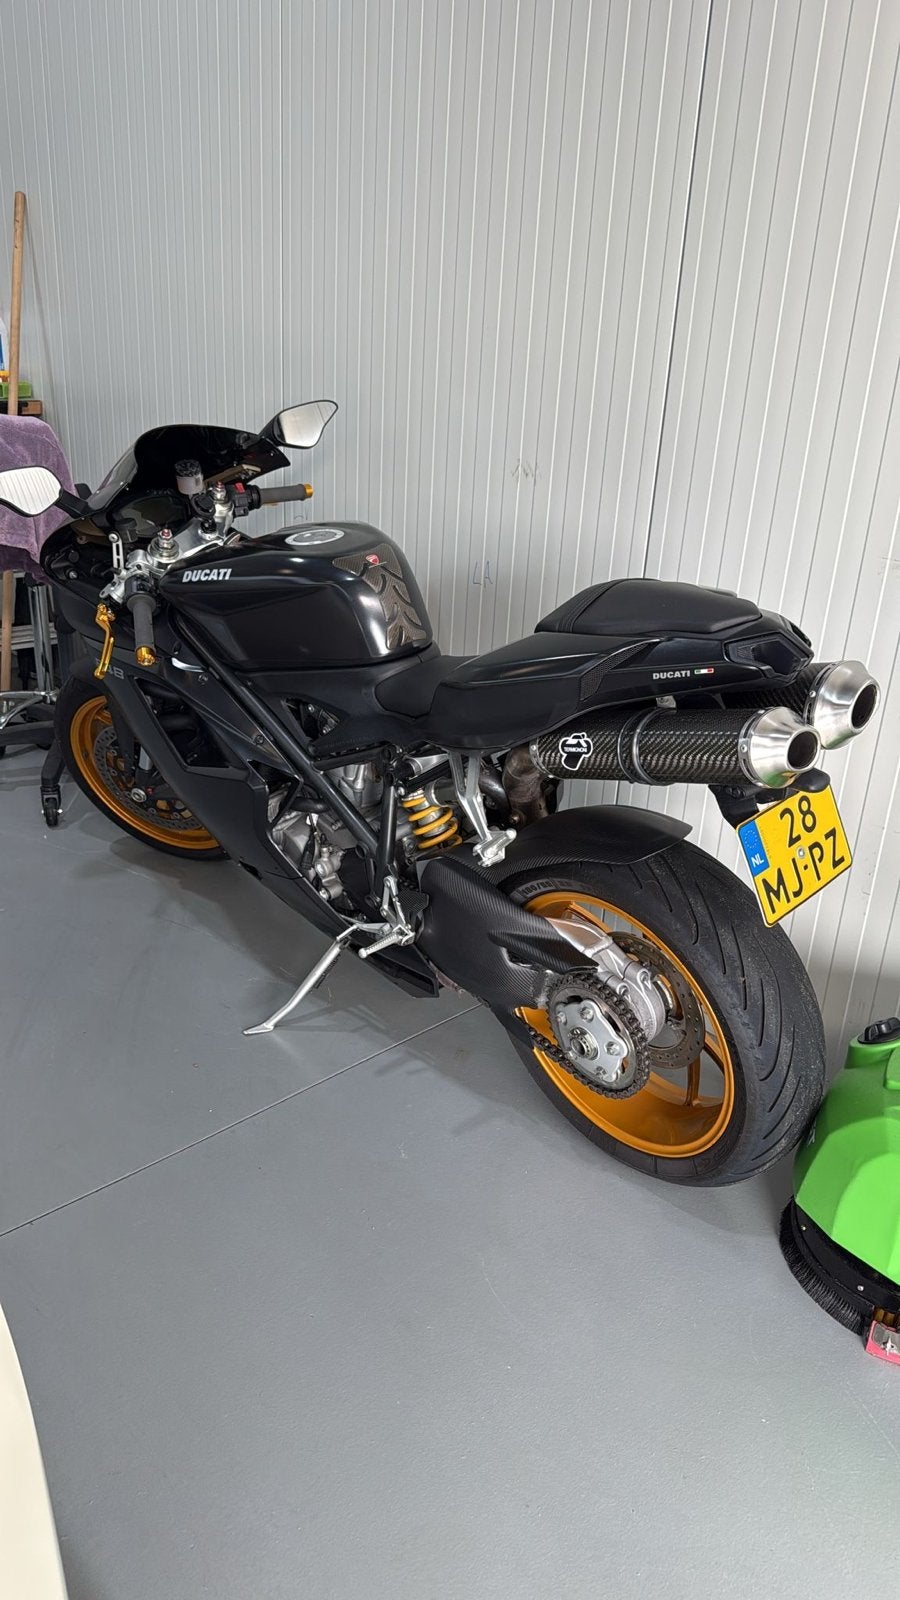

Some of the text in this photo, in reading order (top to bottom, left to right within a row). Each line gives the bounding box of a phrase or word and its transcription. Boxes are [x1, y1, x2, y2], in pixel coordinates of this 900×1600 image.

[182, 568, 232, 583] DUCATI
[652, 669, 691, 680] DUCATI
[779, 795, 817, 848] 28
[750, 853, 765, 868] NL
